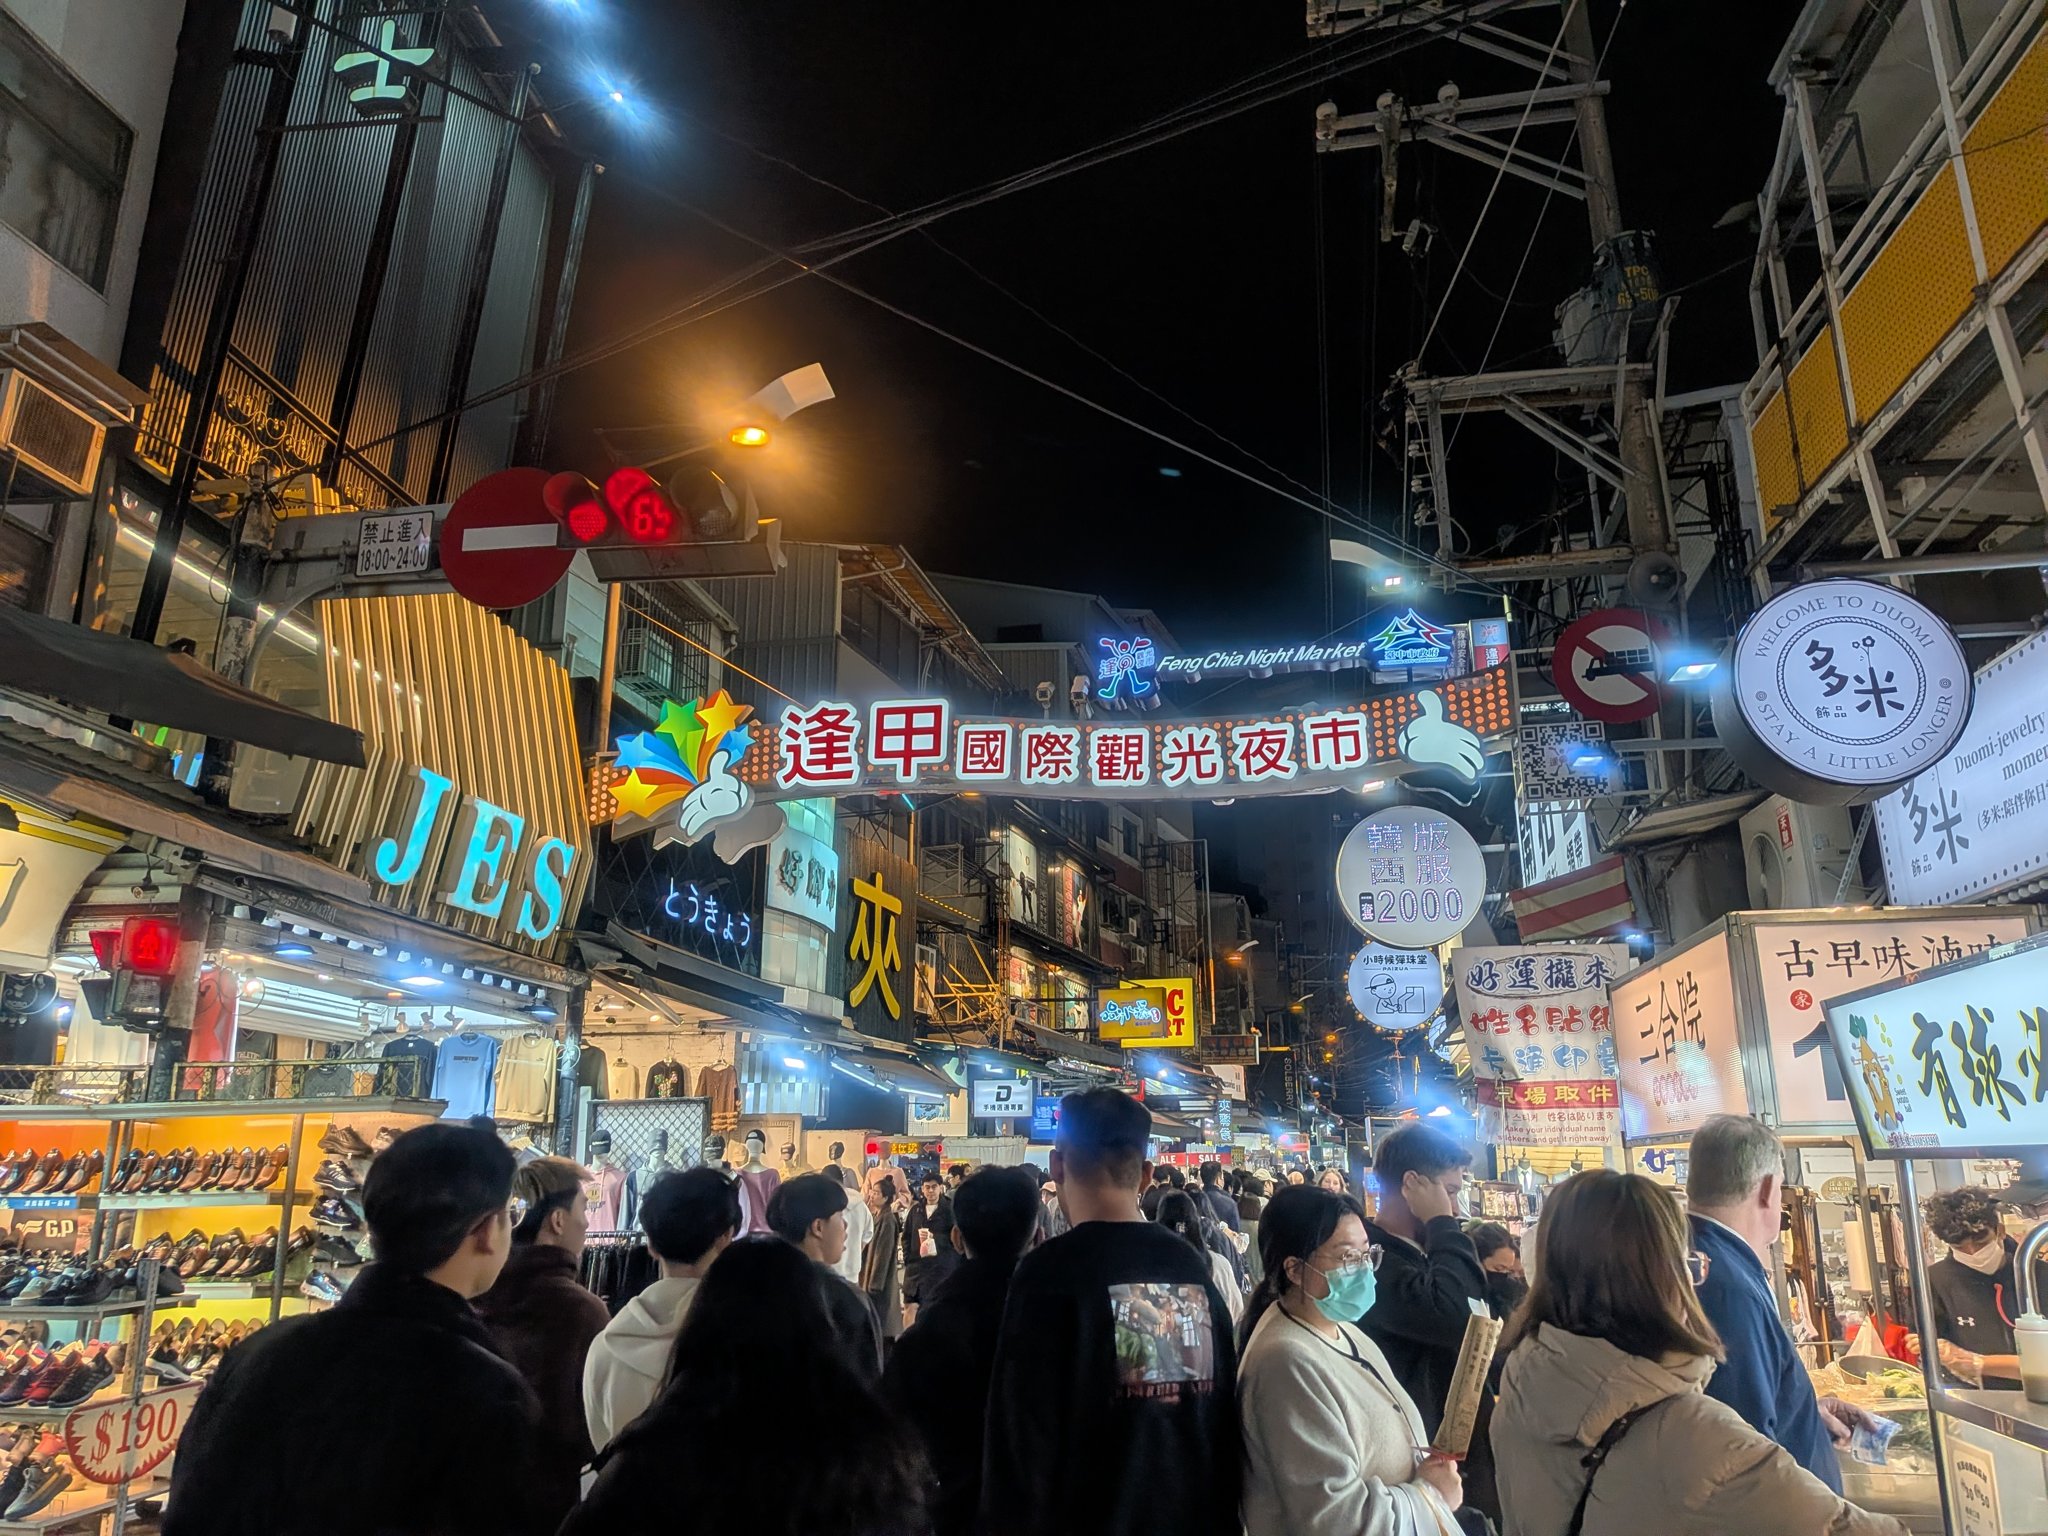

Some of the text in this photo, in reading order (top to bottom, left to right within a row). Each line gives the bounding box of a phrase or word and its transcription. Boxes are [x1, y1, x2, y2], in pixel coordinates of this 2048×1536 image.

[362, 518, 428, 546] 禁止進入
[360, 542, 428, 573] 18:00~24:00
[1755, 594, 1936, 658] WELCOME TO DUOMI
[1157, 656, 1204, 672] Feng
[1203, 650, 1244, 669] Chia
[1243, 647, 1295, 668] Night
[1293, 641, 1368, 662] Market
[1804, 639, 1905, 718] 多米
[1815, 704, 1848, 720] 飾品
[777, 698, 1370, 789] 逢甲國際觀光夜市
[1757, 694, 1954, 771] STAY A LITTLE LONGER
[1953, 711, 2046, 774] Duomi-jewelry
[1977, 780, 2048, 833] (多米:陪伴你日
[375, 766, 575, 941] JES
[1367, 822, 1450, 854] 韓版
[1368, 854, 1453, 886] 西服
[664, 876, 751, 947] とうきょう
[1377, 888, 1463, 923] 2000
[1362, 954, 1428, 966] 小時候彈珠堂
[1468, 954, 1615, 993] 好運攏來
[1635, 970, 1707, 1066] 三合院
[1284, 1056, 1295, 1107] SOLBERRY
[1494, 1082, 1614, 1105] 現場取件
[1527, 1127, 1544, 1135] your
[1544, 1125, 1582, 1133] individual
[1548, 1136, 1560, 1144] get
[1569, 1135, 1587, 1143] right
[1198, 1154, 1221, 1164] SALE
[45, 1219, 74, 1237] G.P
[90, 1398, 178, 1466] $190
